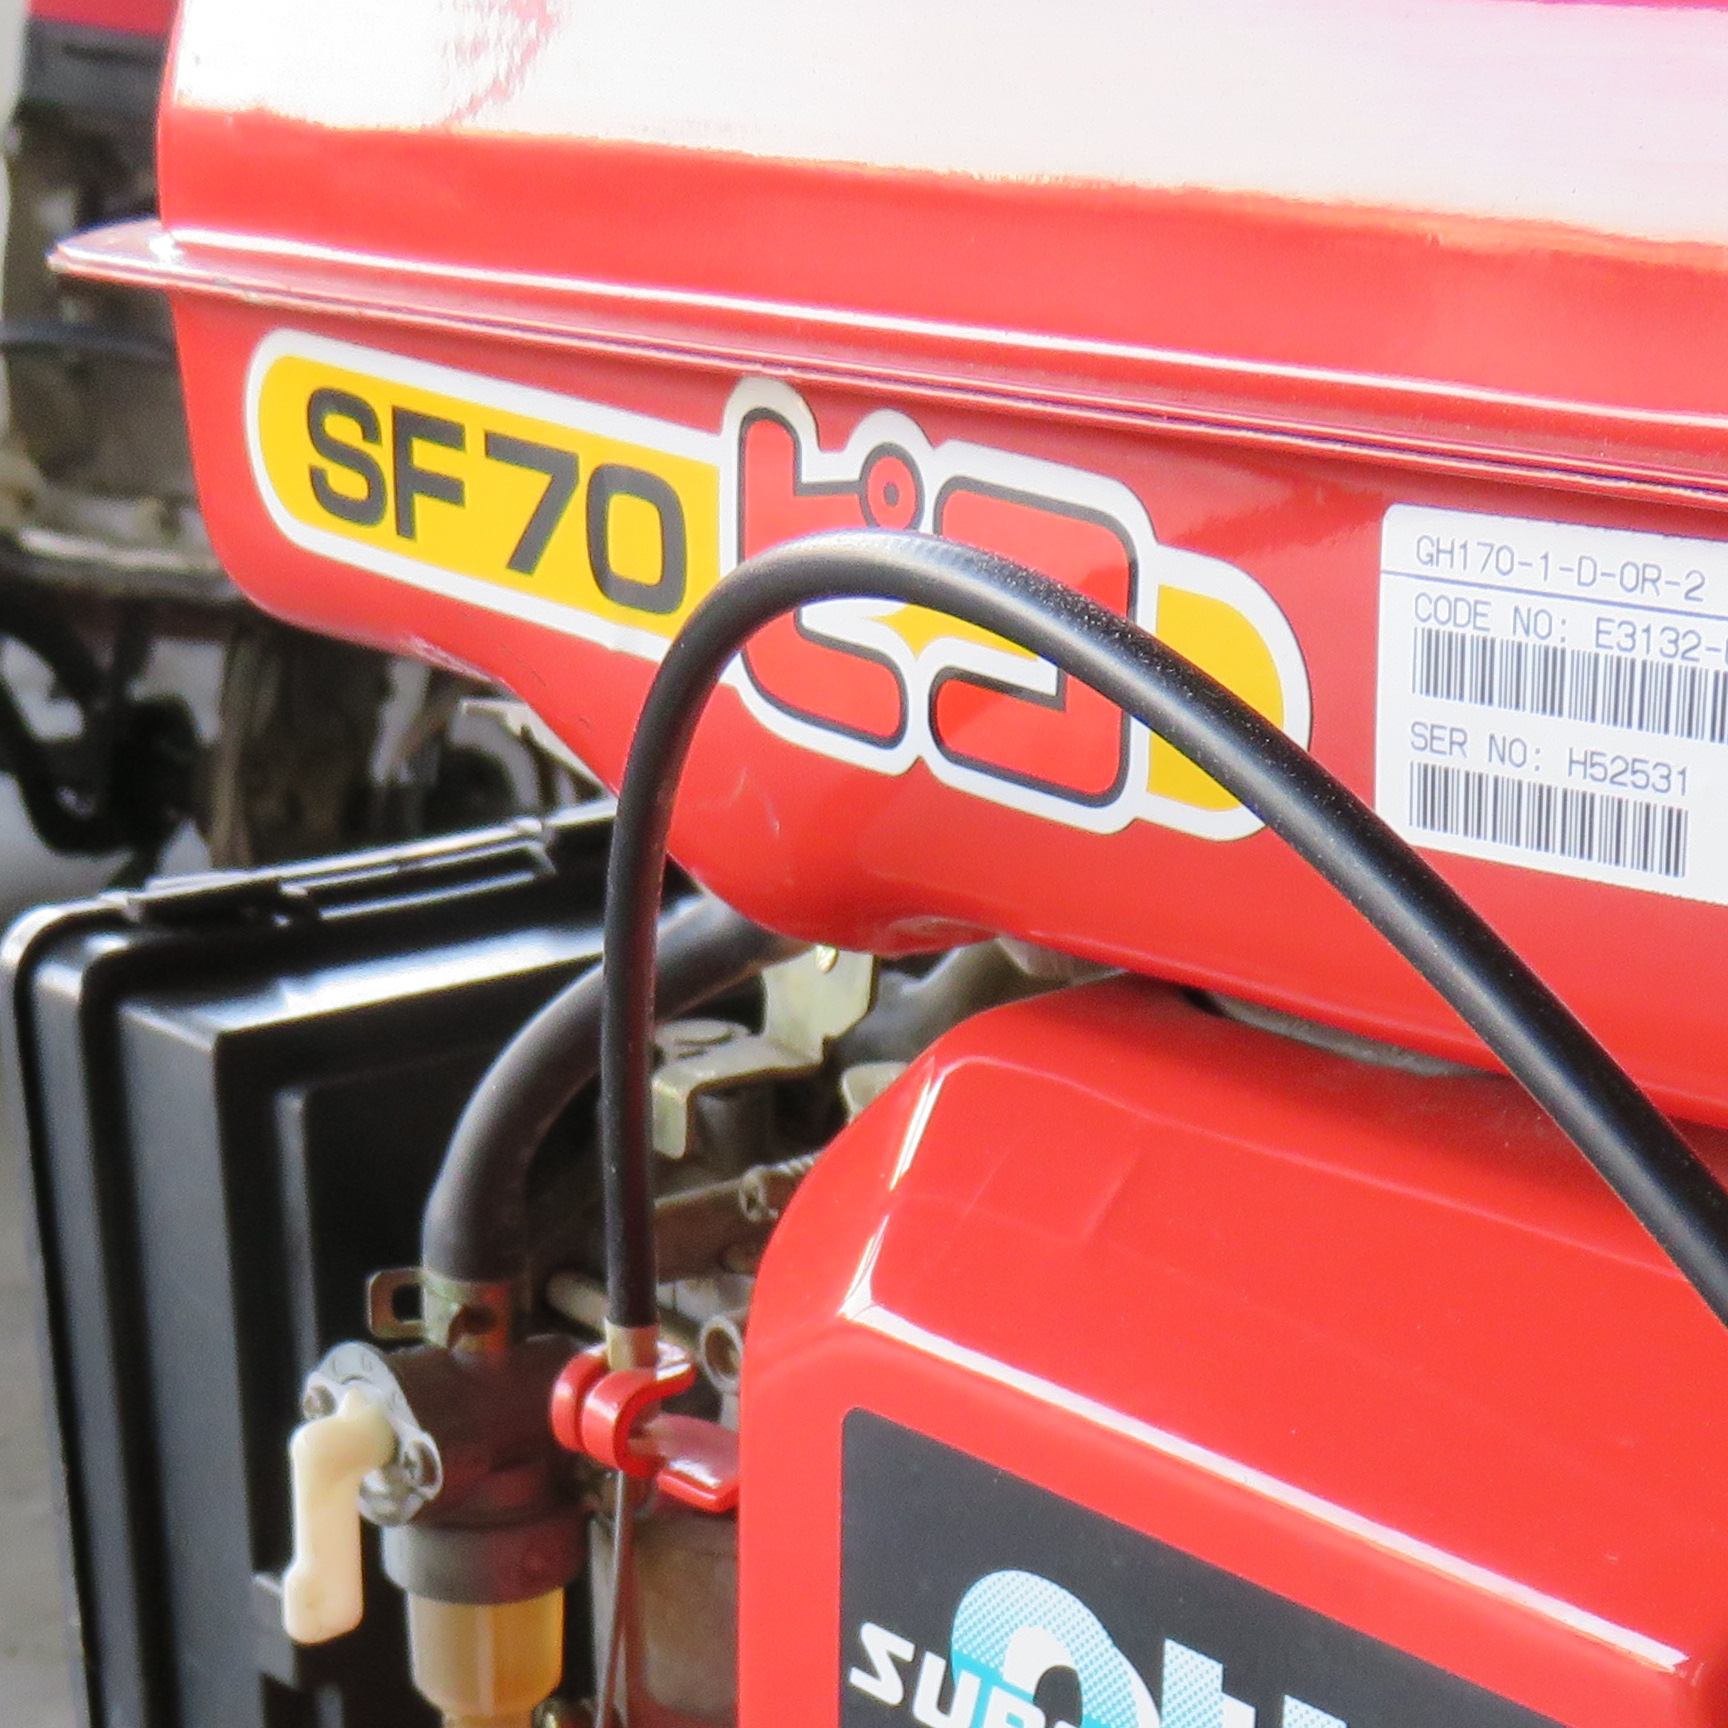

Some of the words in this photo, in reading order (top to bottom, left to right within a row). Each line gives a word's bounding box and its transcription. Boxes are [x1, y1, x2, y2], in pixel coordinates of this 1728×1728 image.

[1413, 592, 1491, 633] CODE
[1511, 605, 1568, 643] NO:
[1409, 721, 1468, 757] SER
[1488, 733, 1542, 771] NO:
[1567, 747, 1689, 797] H52531
